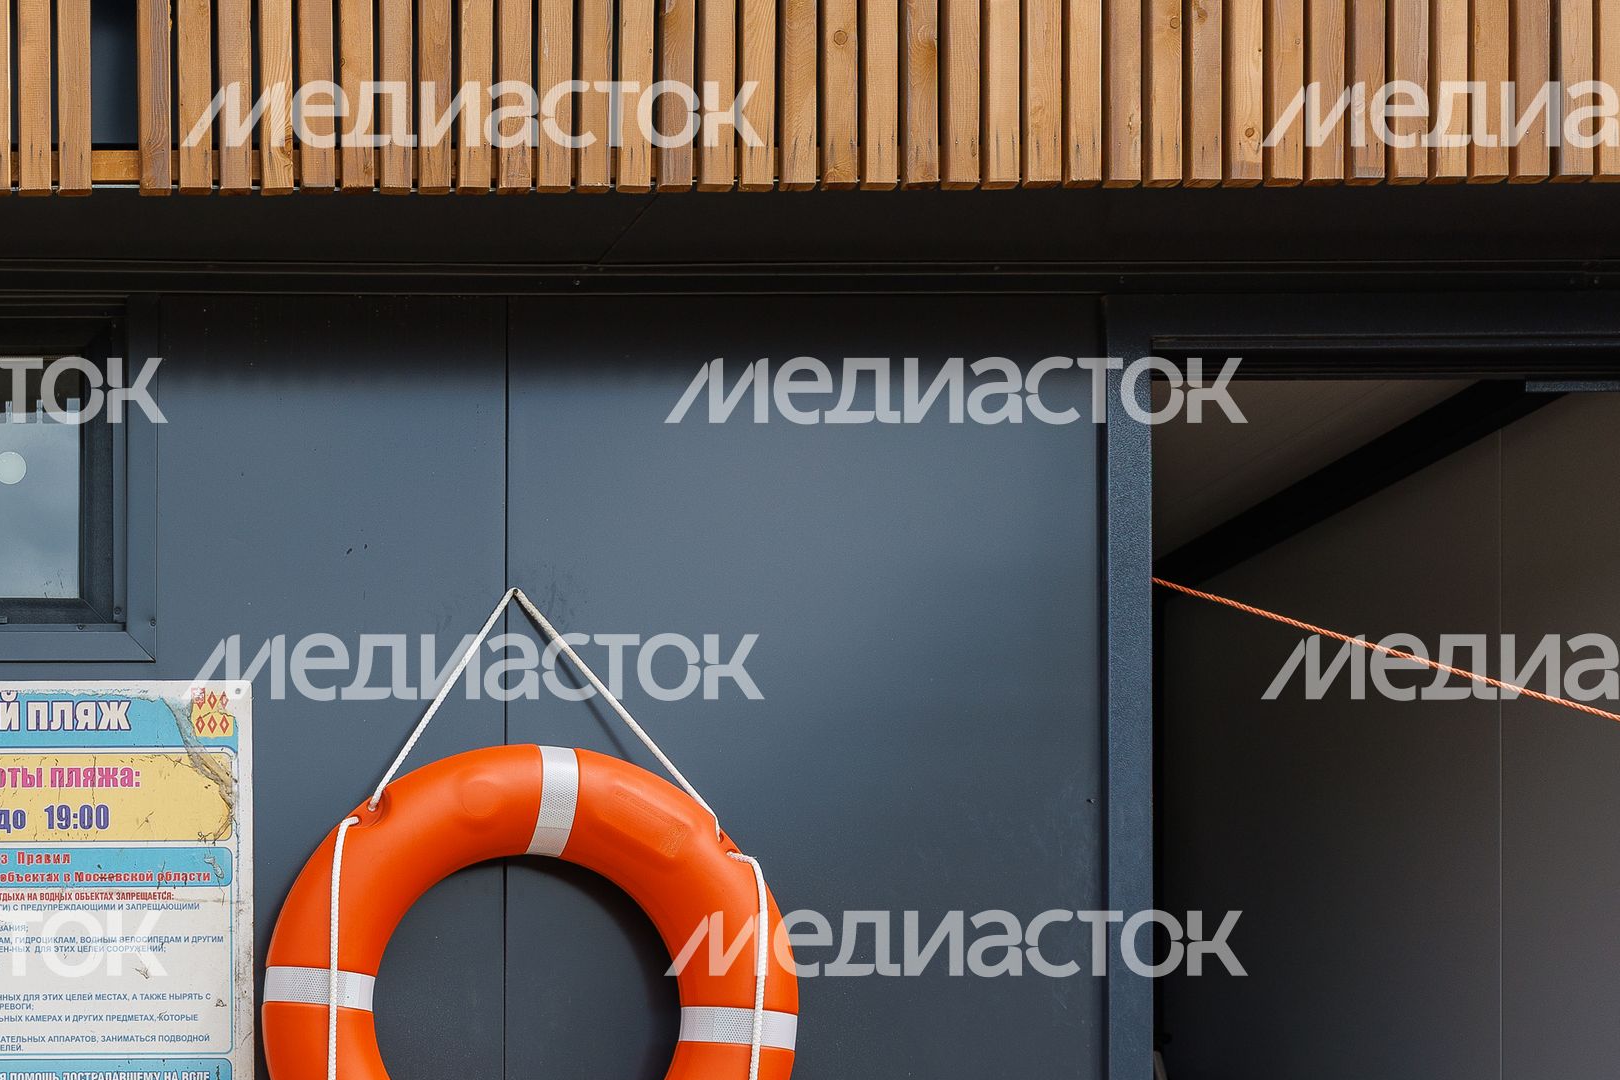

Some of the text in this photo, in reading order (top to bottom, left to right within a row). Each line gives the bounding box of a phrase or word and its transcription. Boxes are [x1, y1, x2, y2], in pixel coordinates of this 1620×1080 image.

[26, 700, 131, 733] пляж
[50, 765, 141, 790] пляжа:
[44, 803, 111, 831] 19:00
[17, 851, 72, 866] Правил
[0, 872, 59, 883] объектах
[74, 870, 153, 882] Московской
[157, 871, 211, 882] области
[27, 893, 37, 901] НА
[39, 892, 72, 901] ВОДНЫХ
[74, 892, 113, 901] ОБЪЕКТАХ
[115, 892, 175, 902] ЗАПРЕЩАЕТСЯ:
[20, 904, 116, 912] ПРЕДУПРЕЖДАЮЩИМИ
[125, 902, 200, 912] ЗАПРЕЩАЮЩИМИ
[24, 1014, 62, 1022] КАМЕРАХ
[71, 1014, 103, 1023] ДРУГИХ
[159, 1013, 198, 1022] КОТОРЫЕ
[101, 1034, 157, 1043] ЗАНИМАТЬСЯ
[158, 1033, 210, 1044] ПОДВОДНОЙ
